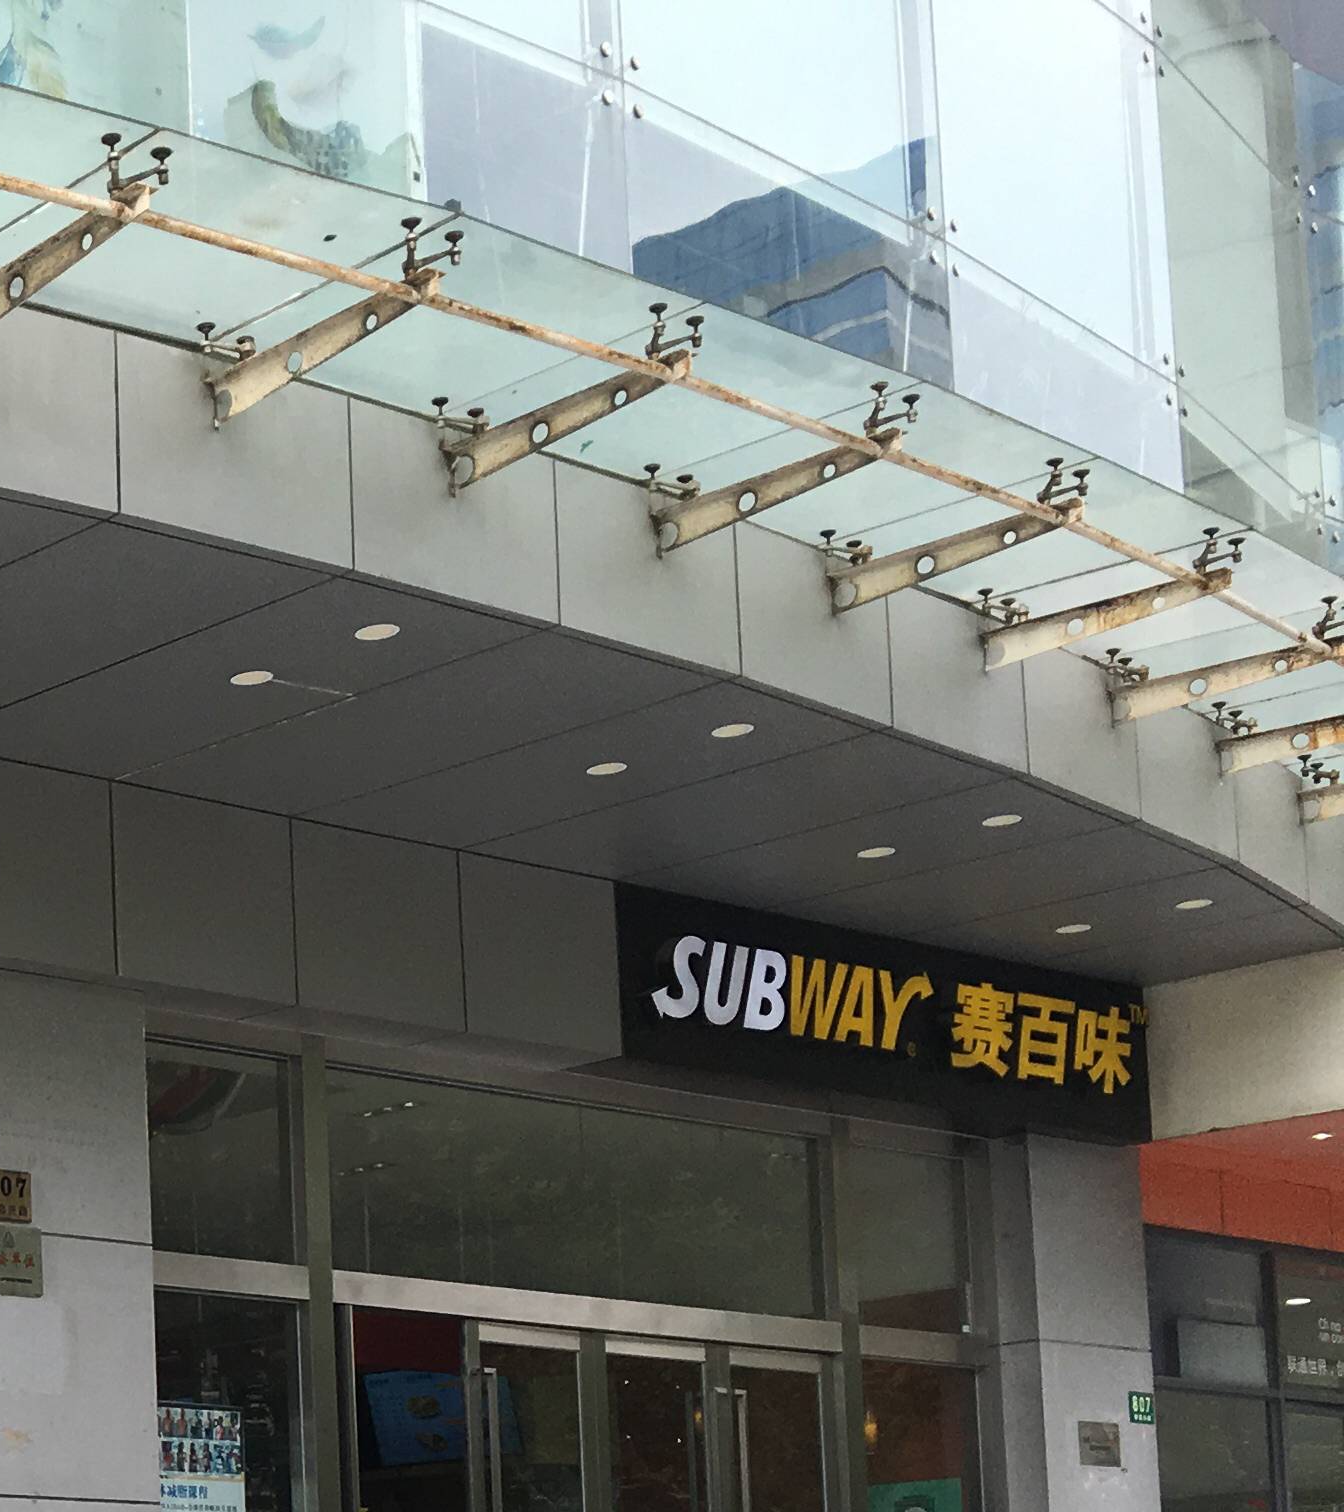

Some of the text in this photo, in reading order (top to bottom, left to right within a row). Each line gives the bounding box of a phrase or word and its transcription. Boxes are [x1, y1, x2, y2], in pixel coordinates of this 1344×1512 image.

[651, 935, 934, 1051] SUBWAY
[951, 982, 1132, 1094] 赛百味
[1132, 1395, 1151, 1412] 807
